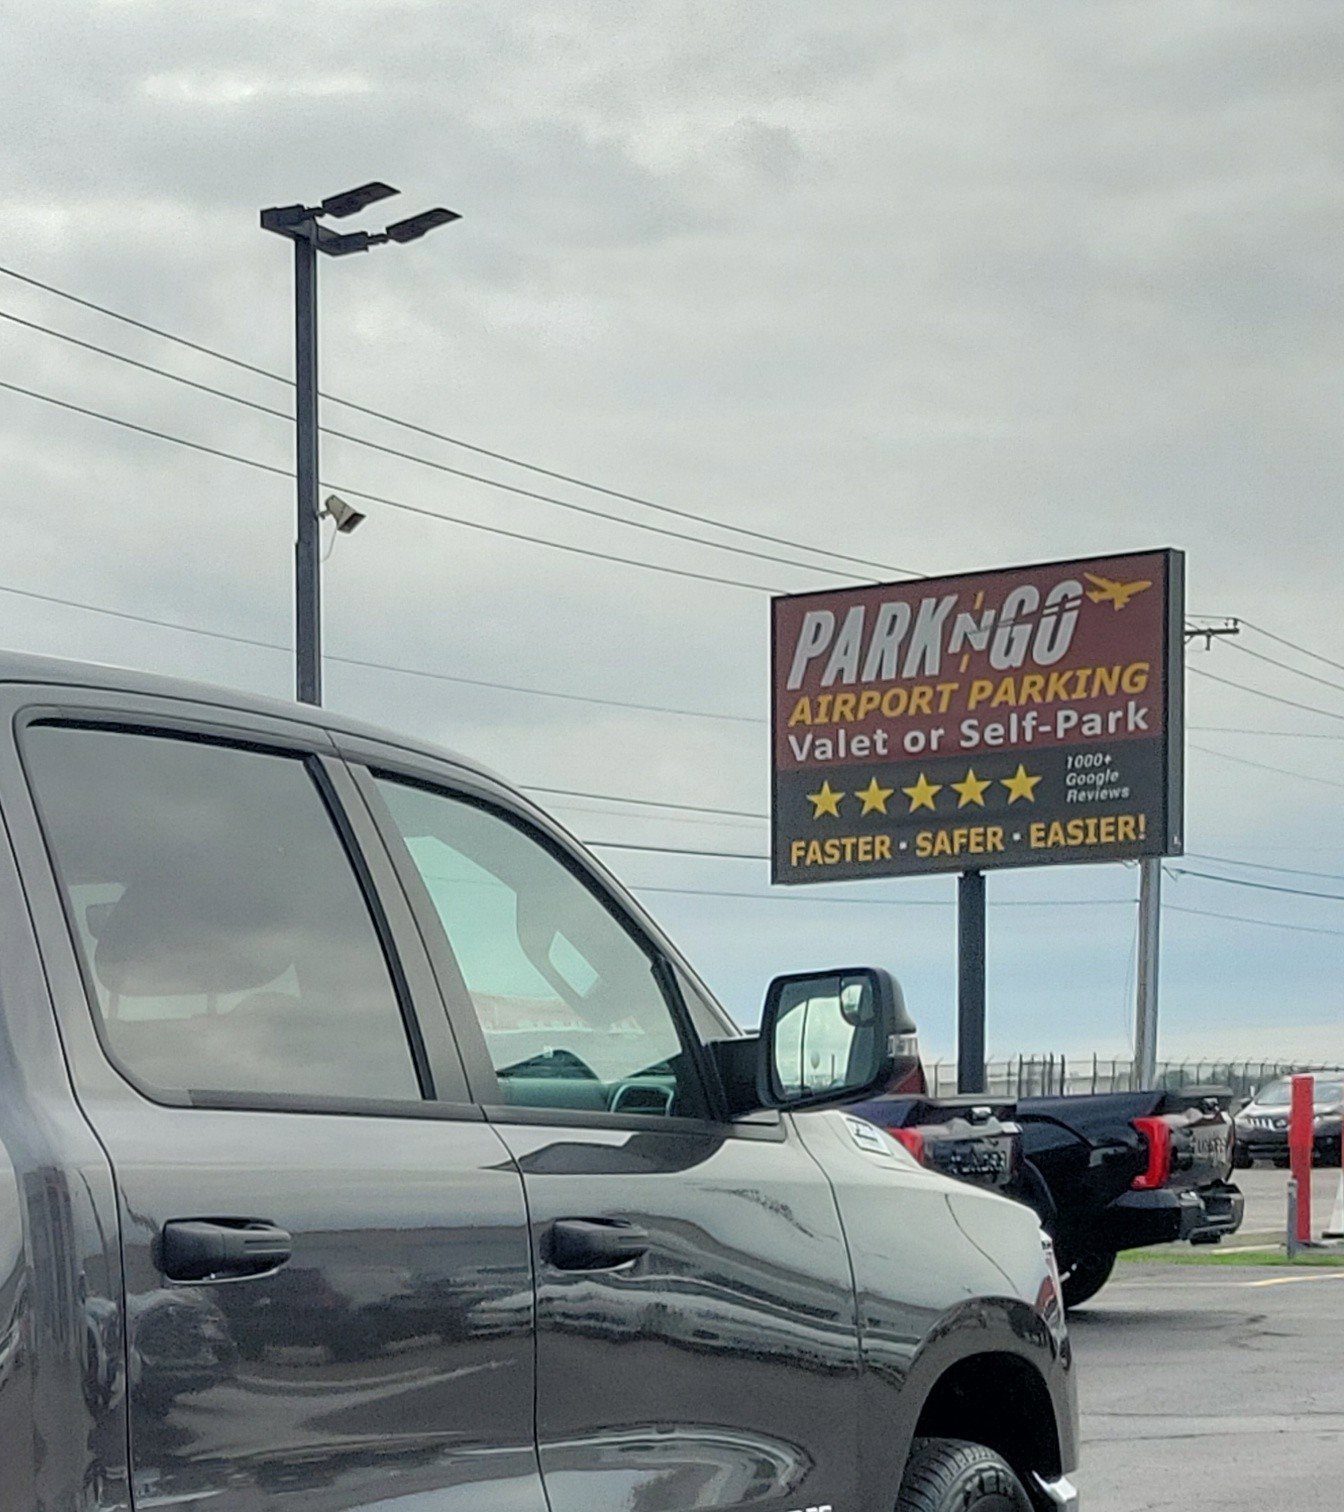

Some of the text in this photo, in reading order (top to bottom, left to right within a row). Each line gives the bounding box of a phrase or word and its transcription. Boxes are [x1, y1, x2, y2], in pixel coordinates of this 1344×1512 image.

[787, 594, 957, 690] PARK
[988, 579, 1084, 671] GO
[788, 662, 1150, 727] AIRPORT PARKING
[788, 702, 1149, 762] Valet or Self-Park
[1066, 753, 1111, 769] 1000+
[1066, 769, 1119, 788] Google
[1066, 785, 1129, 803] Reviews
[790, 814, 1147, 867] FASTER SAFER EASIER!
